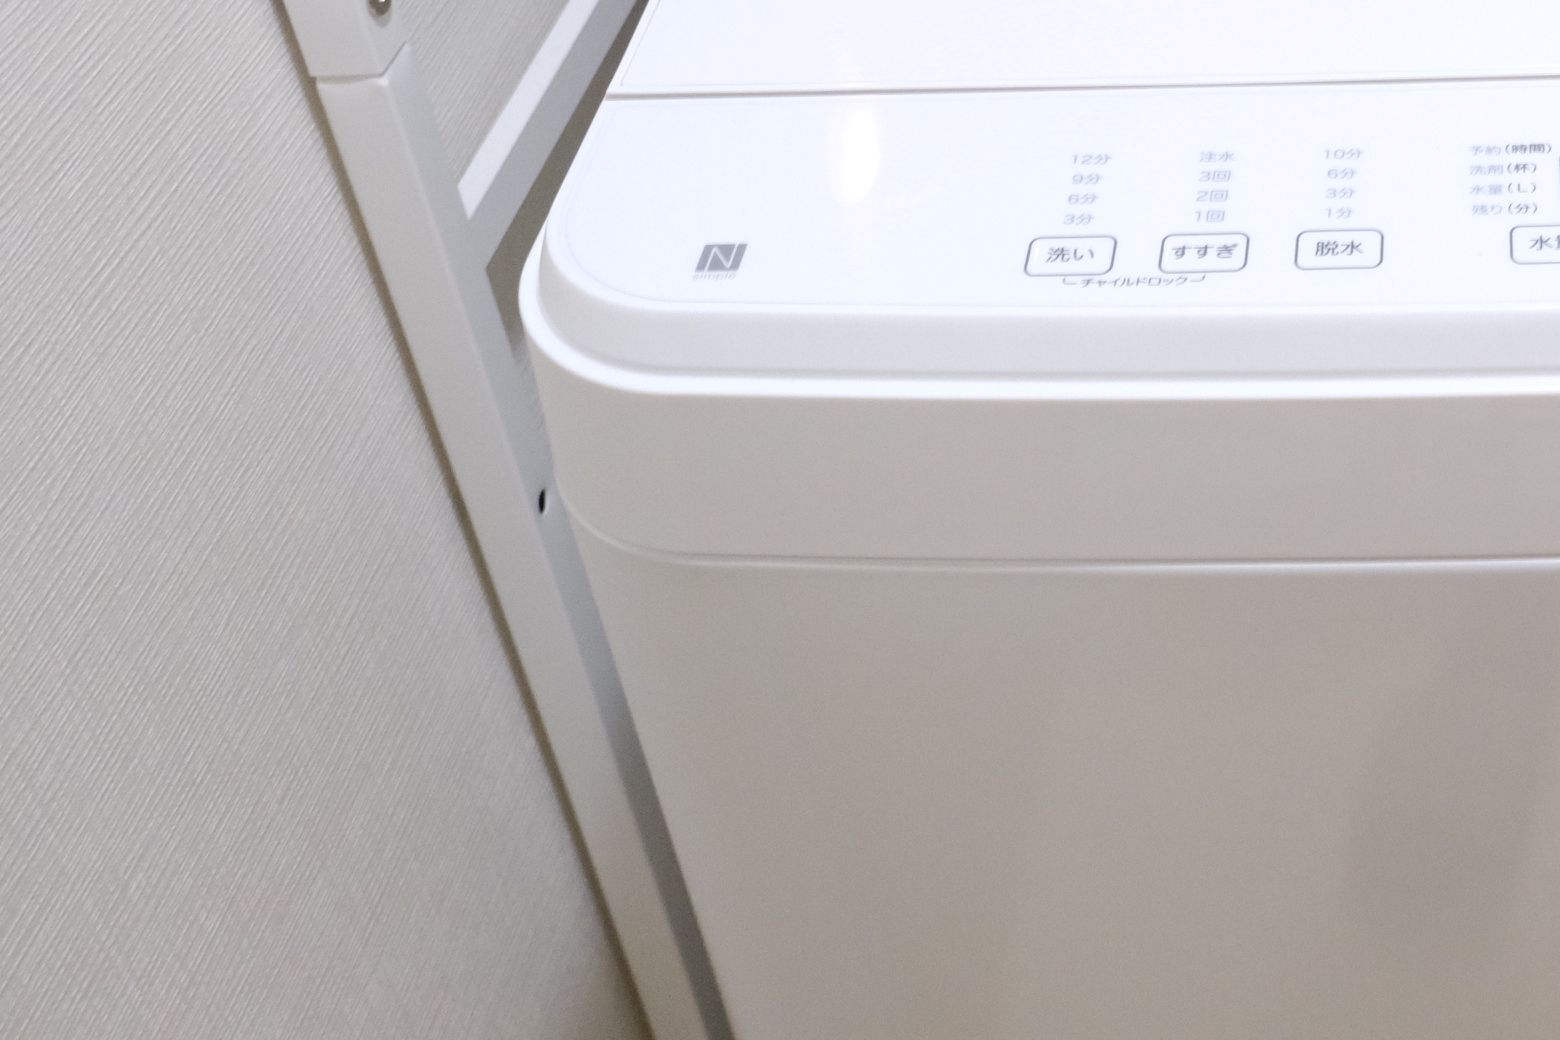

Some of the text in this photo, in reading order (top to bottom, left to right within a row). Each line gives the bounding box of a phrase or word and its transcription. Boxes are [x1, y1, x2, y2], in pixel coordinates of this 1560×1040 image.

[1071, 152, 1113, 166] 12分
[1323, 147, 1364, 161] 10分
[1071, 172, 1104, 186] 9分
[1198, 168, 1233, 183] 3回
[1326, 167, 1359, 180] 6分
[1066, 192, 1100, 206] 6分
[1195, 189, 1231, 203] 2回
[1325, 186, 1357, 200] 3分
[1063, 211, 1096, 226] 3分
[1194, 209, 1226, 224] 1回
[1325, 206, 1355, 220] 1分
[1045, 246, 1095, 263] 洗い
[1171, 243, 1238, 260] すすぎ
[1314, 240, 1363, 257] 脱水
[1080, 276, 1189, 289] チャイルドロック
